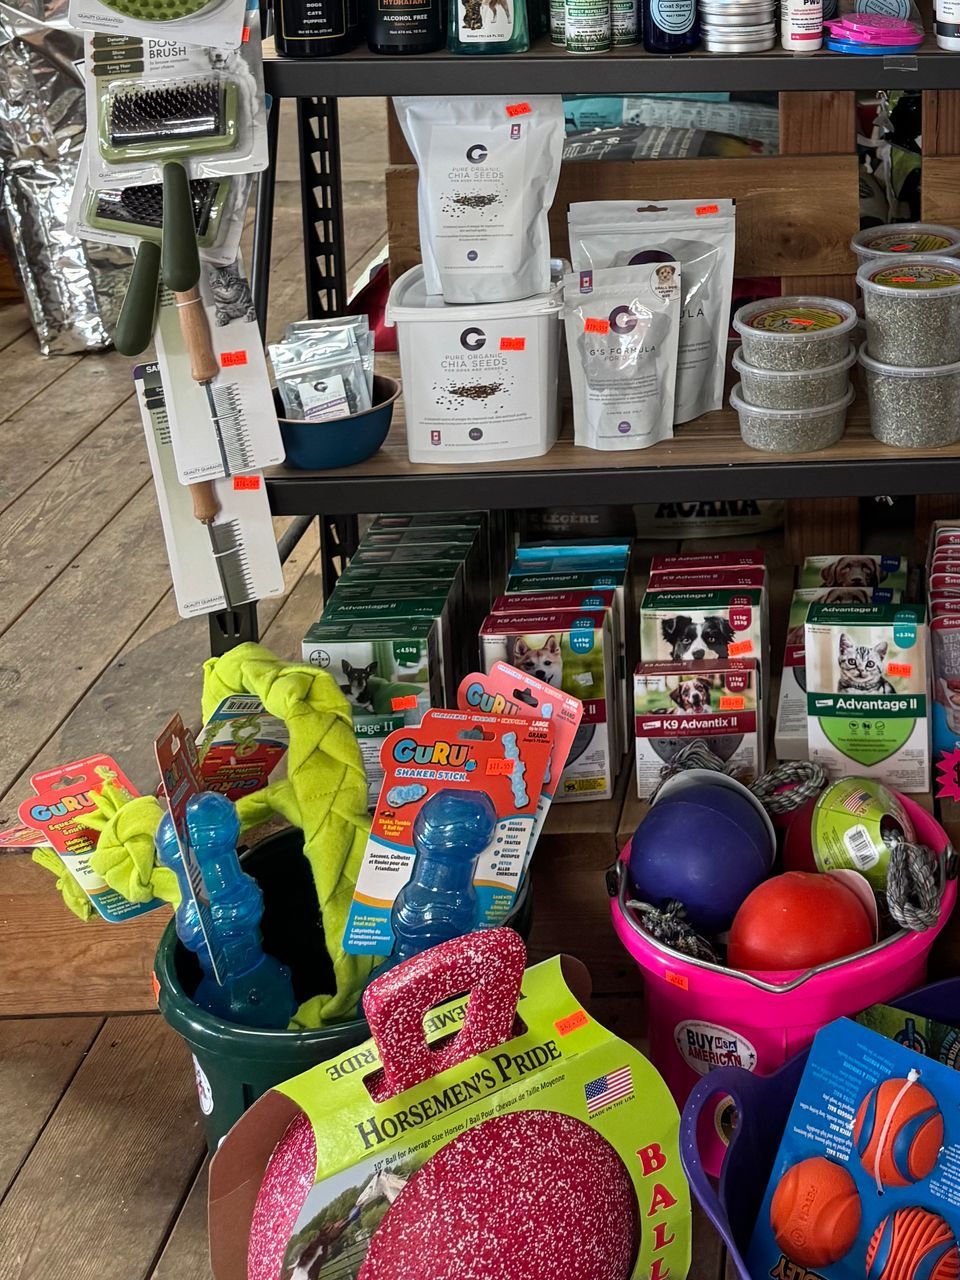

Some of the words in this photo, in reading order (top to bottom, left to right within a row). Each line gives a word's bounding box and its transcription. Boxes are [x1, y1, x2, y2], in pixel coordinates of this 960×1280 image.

[149, 46, 188, 60] BRUSH
[440, 358, 469, 369] CHIA
[471, 357, 509, 368] SEEDS
[835, 697, 908, 712] Advantage
[908, 698, 918, 710] II
[662, 719, 680, 730] K9
[681, 716, 728, 729] Advantix
[729, 716, 738, 728] II
[395, 767, 435, 780] SHAKER
[437, 770, 468, 782] STICK
[686, 1028, 714, 1051] BUY
[714, 1036, 739, 1053] USA
[356, 1066, 497, 1151] HORSEMEN'S
[491, 1039, 563, 1083] PRIDE
[385, 1151, 399, 1167] Ball
[397, 1149, 408, 1162] for
[406, 1136, 432, 1160] Average
[431, 1130, 445, 1145] Size
[443, 1121, 465, 1139] Horses
[468, 1113, 482, 1127] Ball
[480, 1106, 496, 1122] Pour
[494, 1096, 518, 1115] Chevaux
[518, 1091, 526, 1102] de
[524, 1083, 543, 1099] Taille
[539, 1072, 566, 1094] Moyenne
